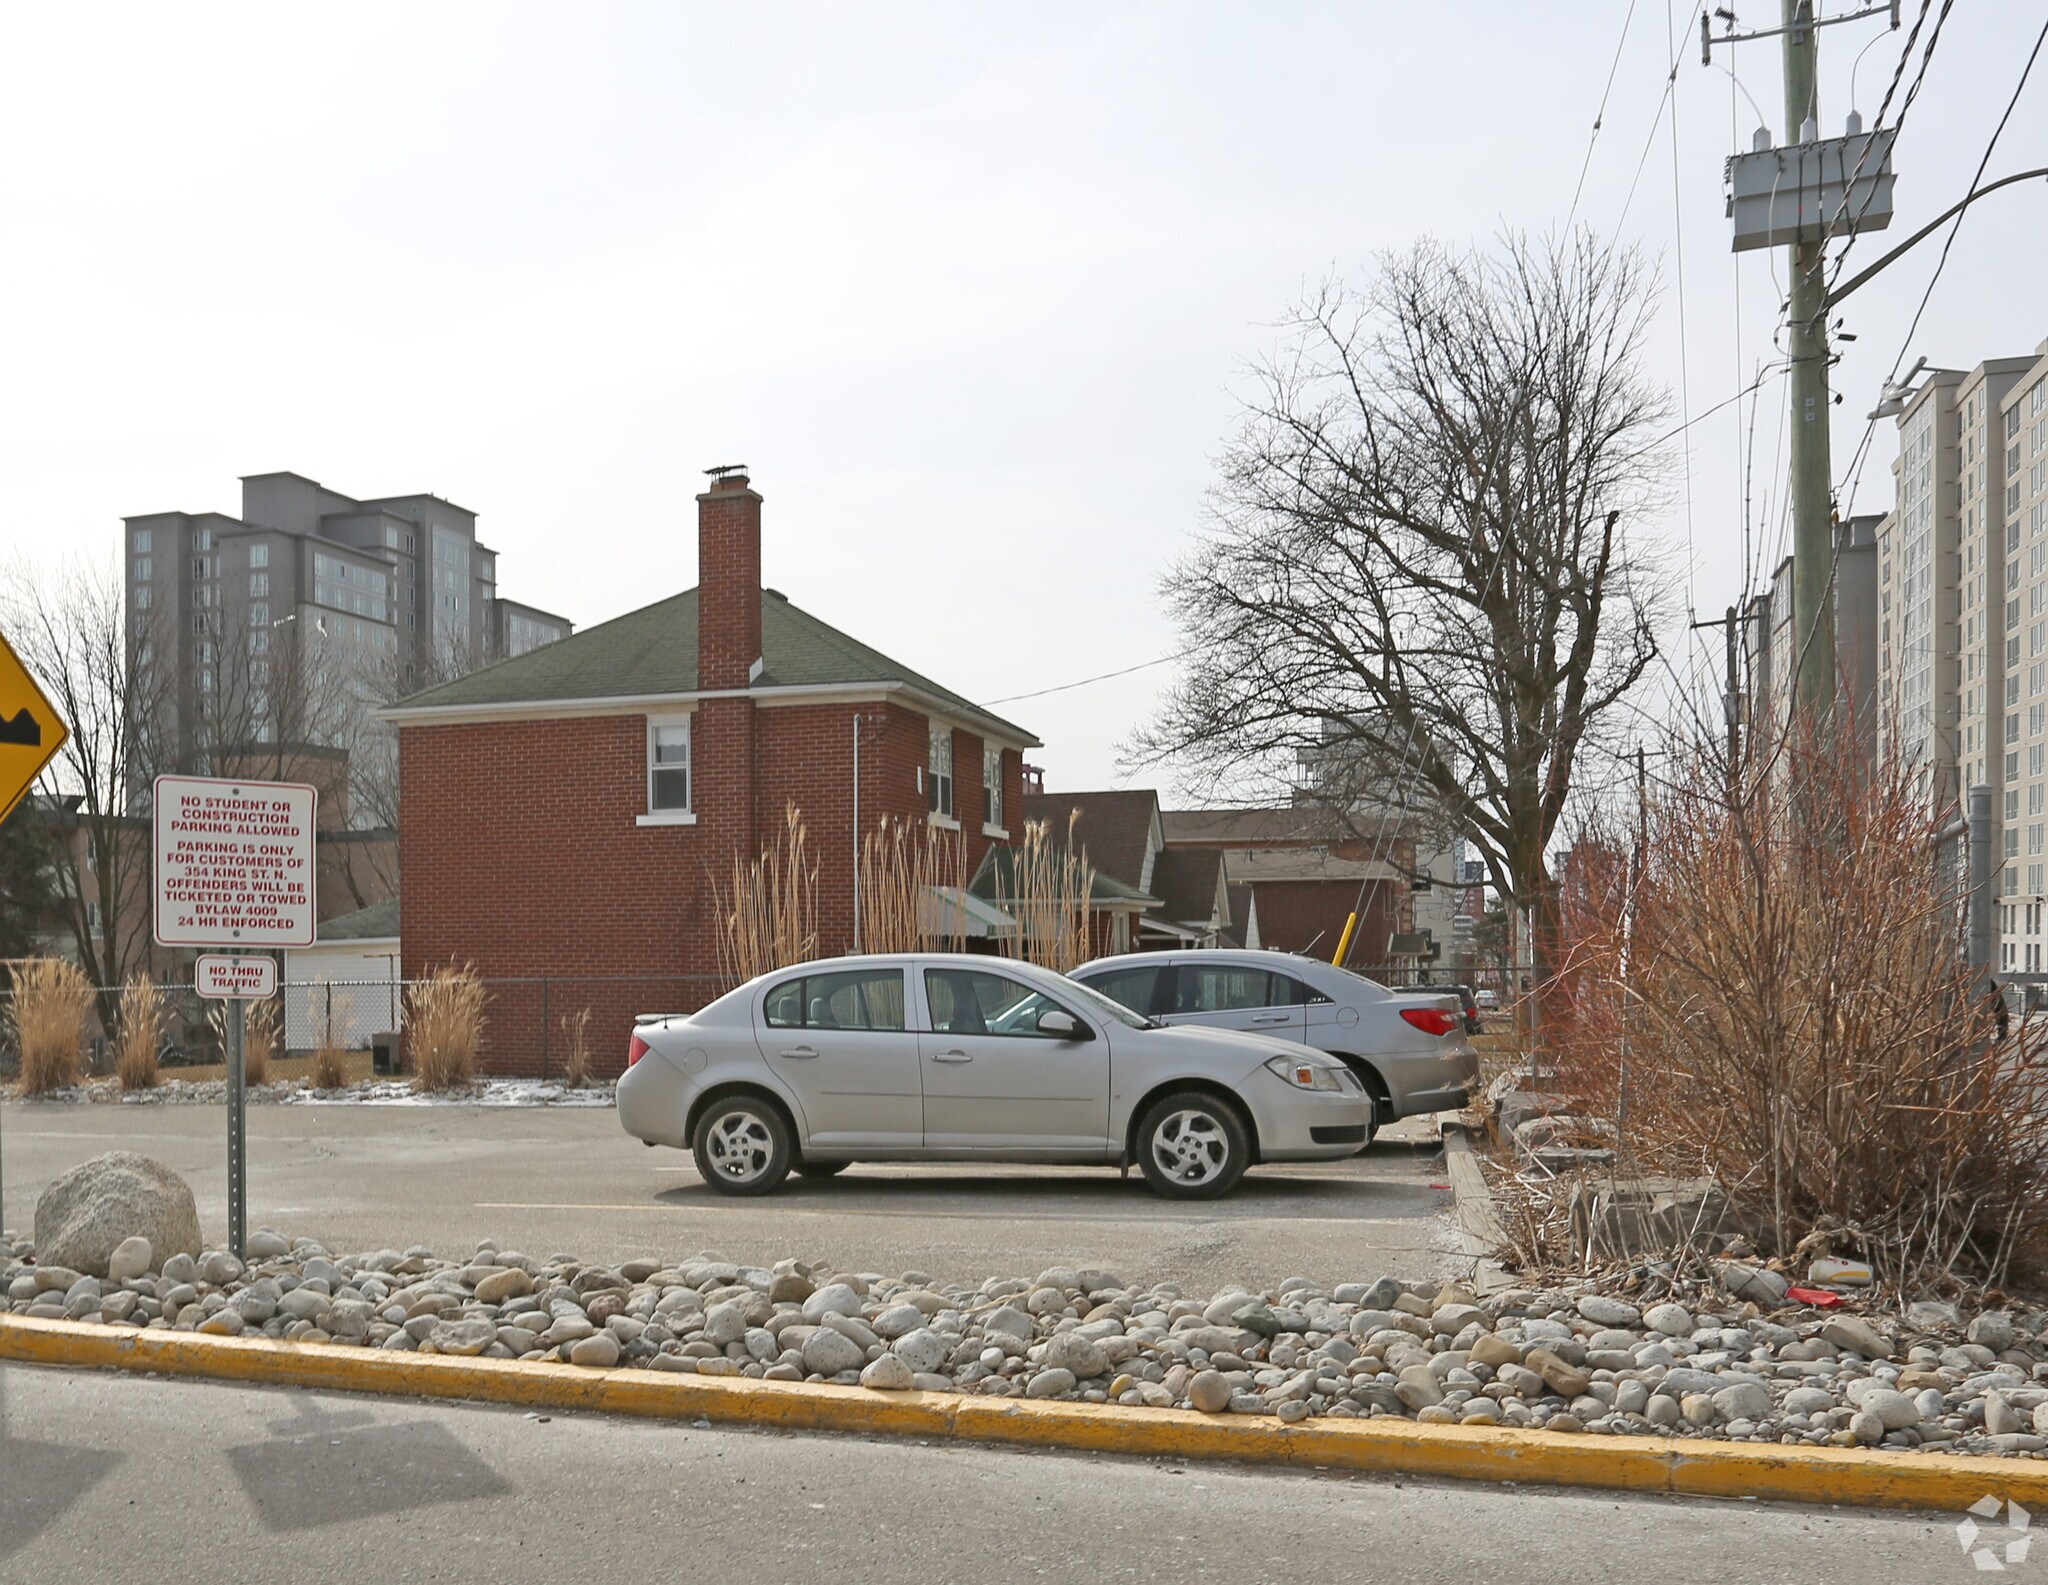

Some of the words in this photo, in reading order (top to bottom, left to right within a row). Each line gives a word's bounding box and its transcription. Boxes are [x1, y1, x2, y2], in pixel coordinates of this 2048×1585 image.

[181, 796, 200, 807] NO
[205, 797, 268, 811] STUDENT
[272, 801, 291, 812] OR
[182, 809, 290, 824] CONSTRUCTION
[171, 820, 232, 833] PARKING
[236, 824, 300, 837] ALLOWED
[177, 841, 238, 854] PARKING
[243, 844, 255, 854] IS
[260, 845, 294, 856] ONLY
[167, 853, 194, 864] FOR
[198, 854, 283, 867] CUSTOMERS
[287, 858, 304, 868] OF
[184, 866, 208, 877] 354
[213, 868, 246, 878] KING
[251, 869, 270, 880] ST.
[274, 870, 288, 880] N.
[166, 878, 248, 891] OFFENDERS
[252, 881, 284, 892] WILL
[288, 882, 304, 892] BE
[164, 890, 232, 902] TICKETED
[236, 892, 255, 903] OR
[259, 894, 306, 905] TOWED
[195, 904, 242, 915] BYLAW
[245, 905, 278, 916] 4009
[178, 915, 194, 926] 24
[198, 916, 218, 927] HR
[222, 917, 294, 929] ENFORCED
[209, 966, 226, 976] NO
[230, 967, 263, 976] THRU
[211, 978, 261, 988] TRAFFIC
